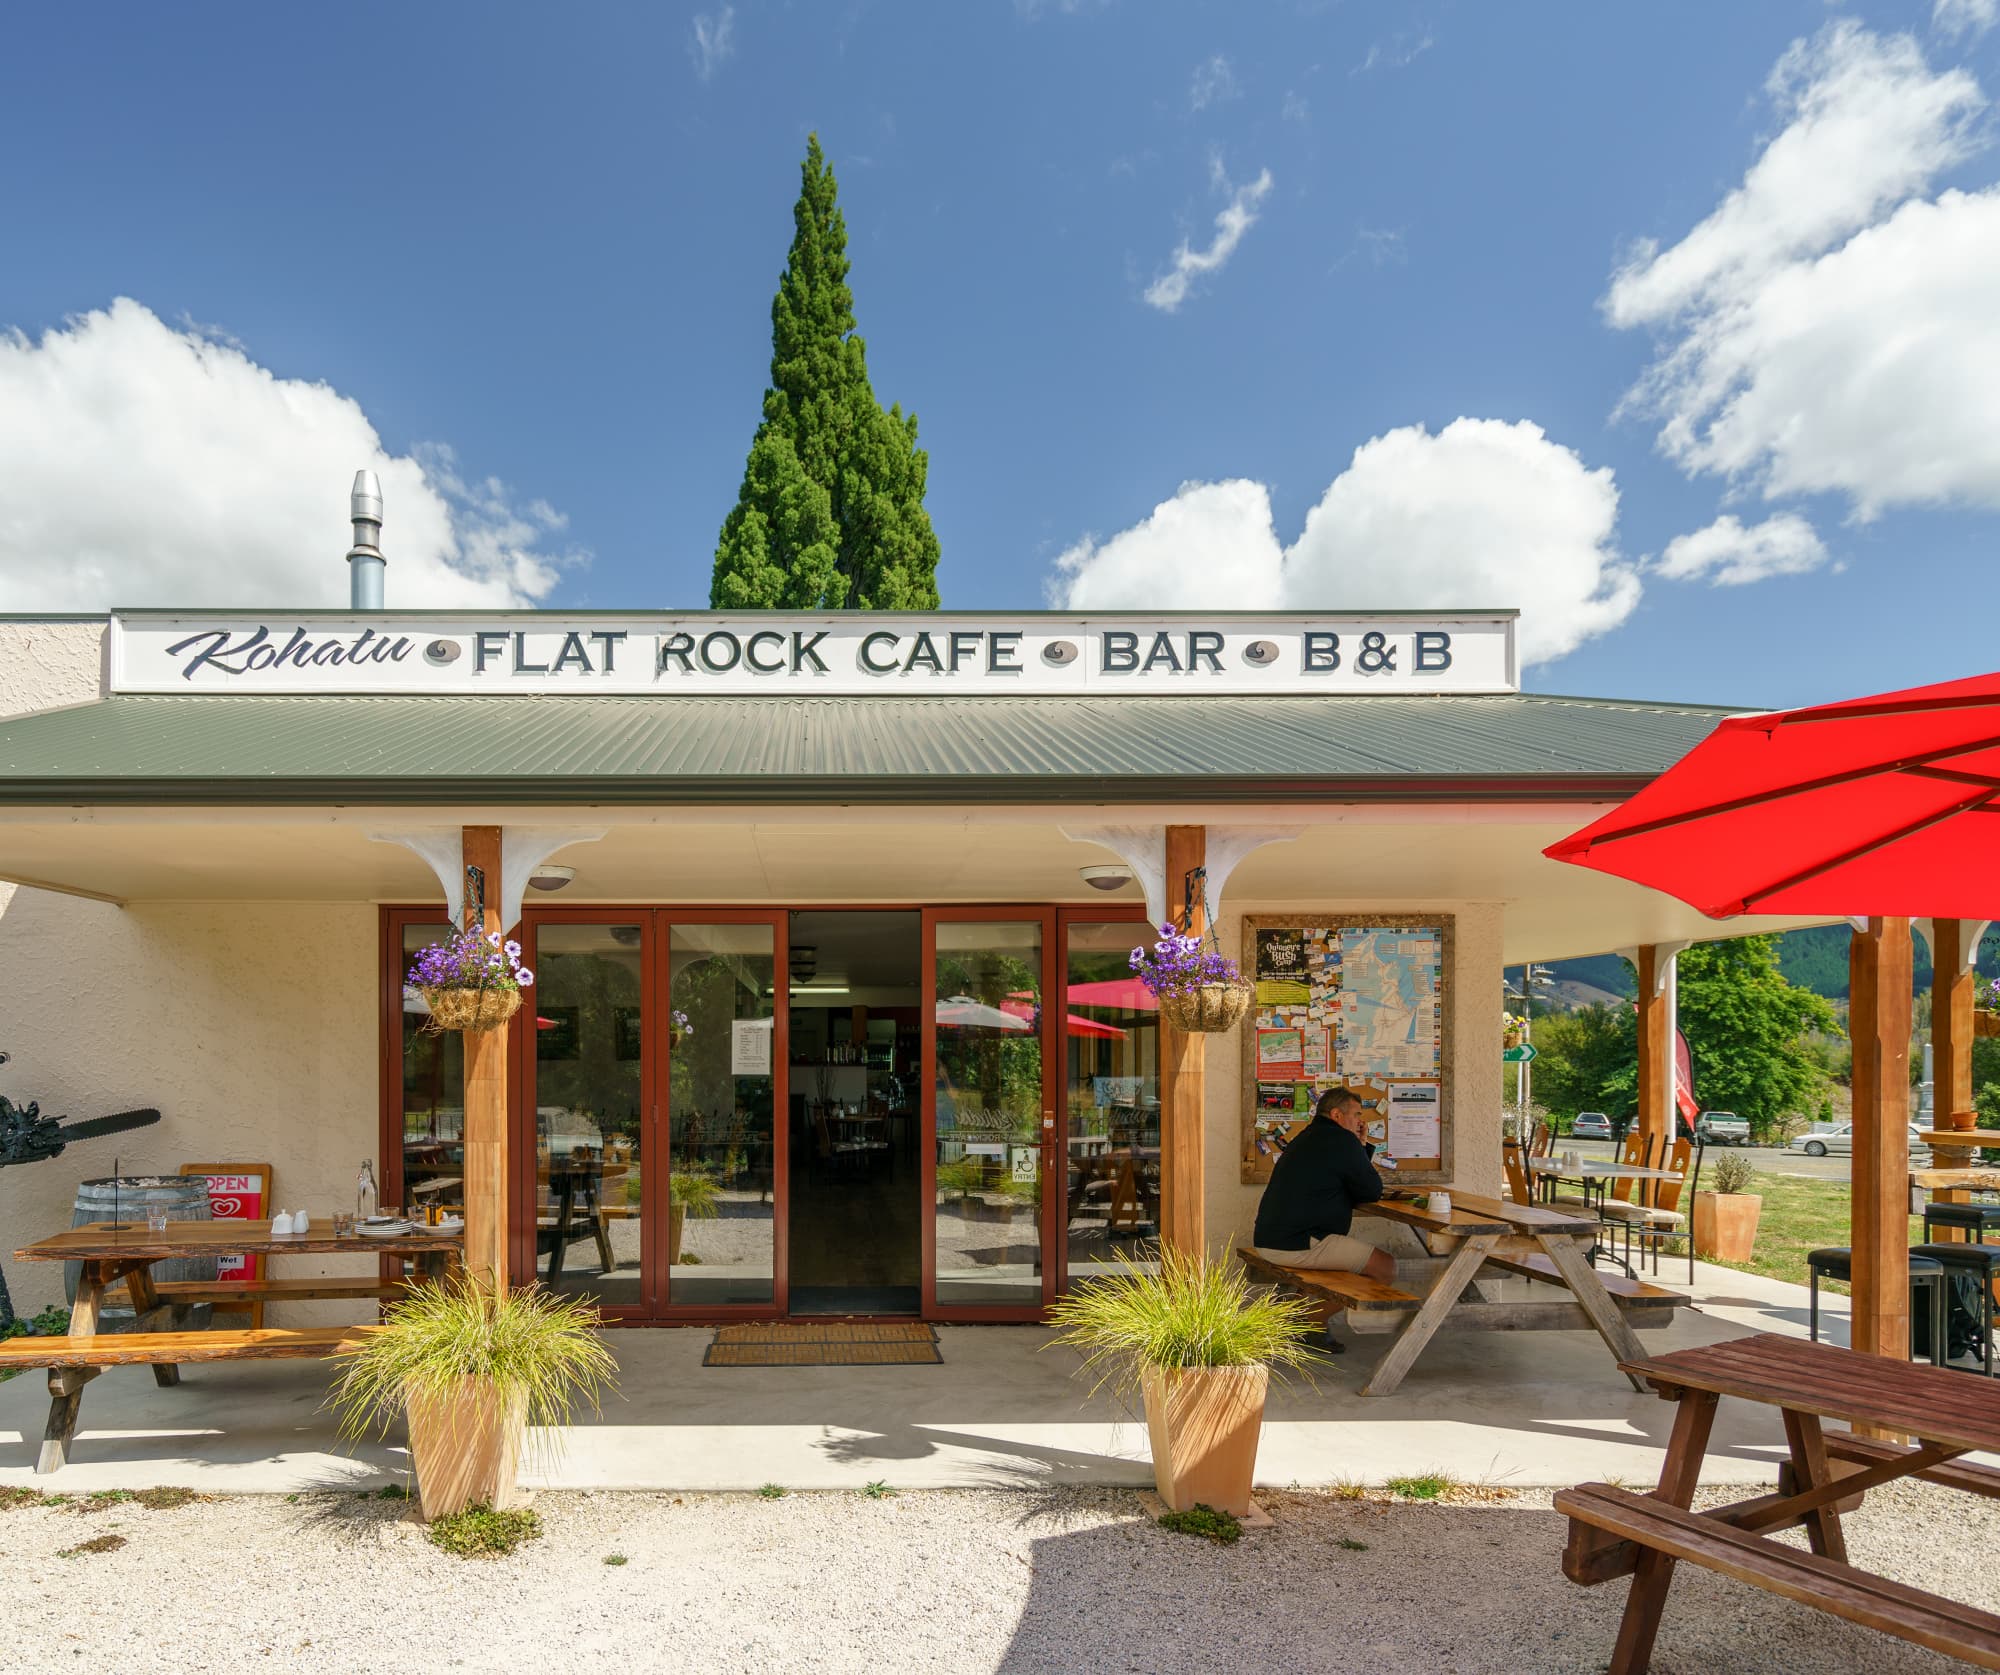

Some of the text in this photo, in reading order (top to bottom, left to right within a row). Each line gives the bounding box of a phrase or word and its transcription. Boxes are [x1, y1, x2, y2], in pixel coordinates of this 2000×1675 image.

[165, 626, 416, 681] Kohatu
[473, 630, 628, 674] FLAT
[657, 631, 832, 675] ROCK
[858, 630, 1024, 674] CAFE
[1101, 631, 1227, 673] BAR
[205, 1176, 249, 1191] OPEN
[220, 1256, 238, 1264] Wet
